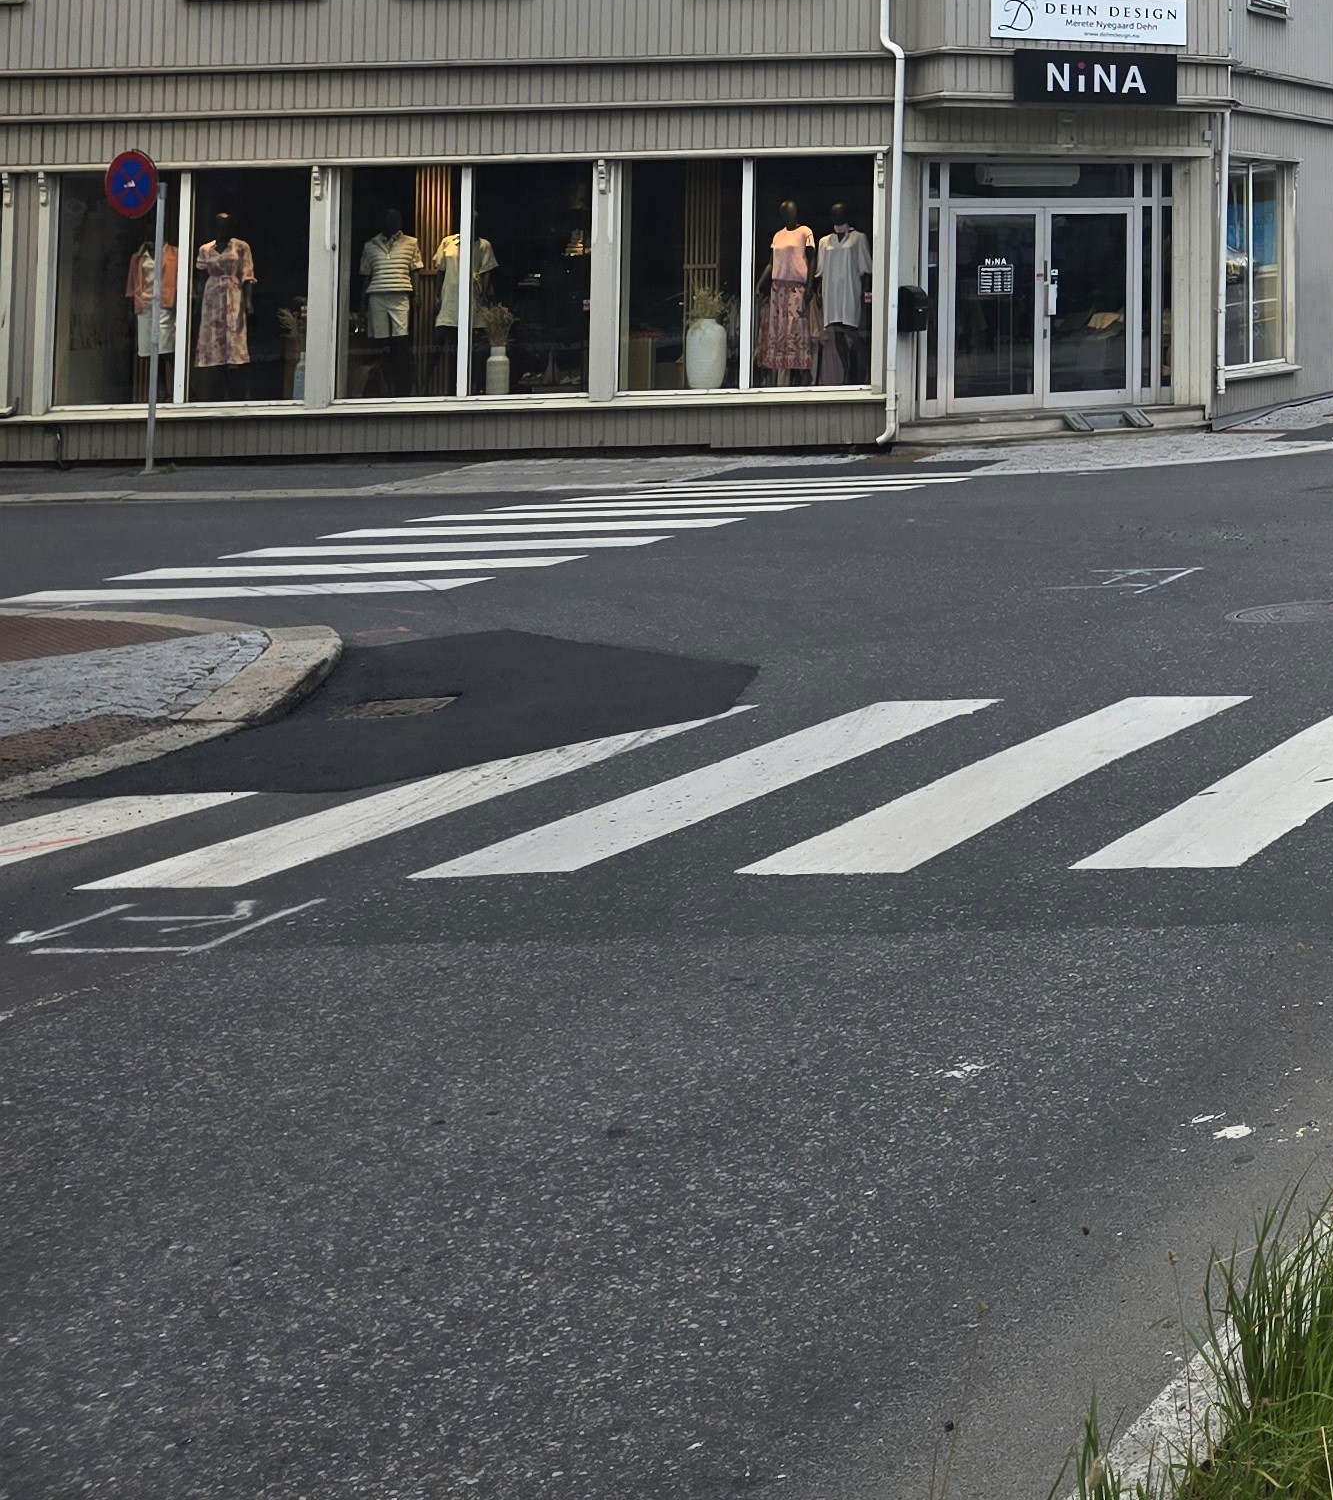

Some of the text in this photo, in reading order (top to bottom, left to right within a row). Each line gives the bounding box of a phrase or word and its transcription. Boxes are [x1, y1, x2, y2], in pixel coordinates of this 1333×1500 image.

[1045, 2, 1178, 20] DEHN DESIGN
[1065, 19, 1158, 31] Merete Nyegaard Dehn
[1046, 62, 1147, 94] NiNA
